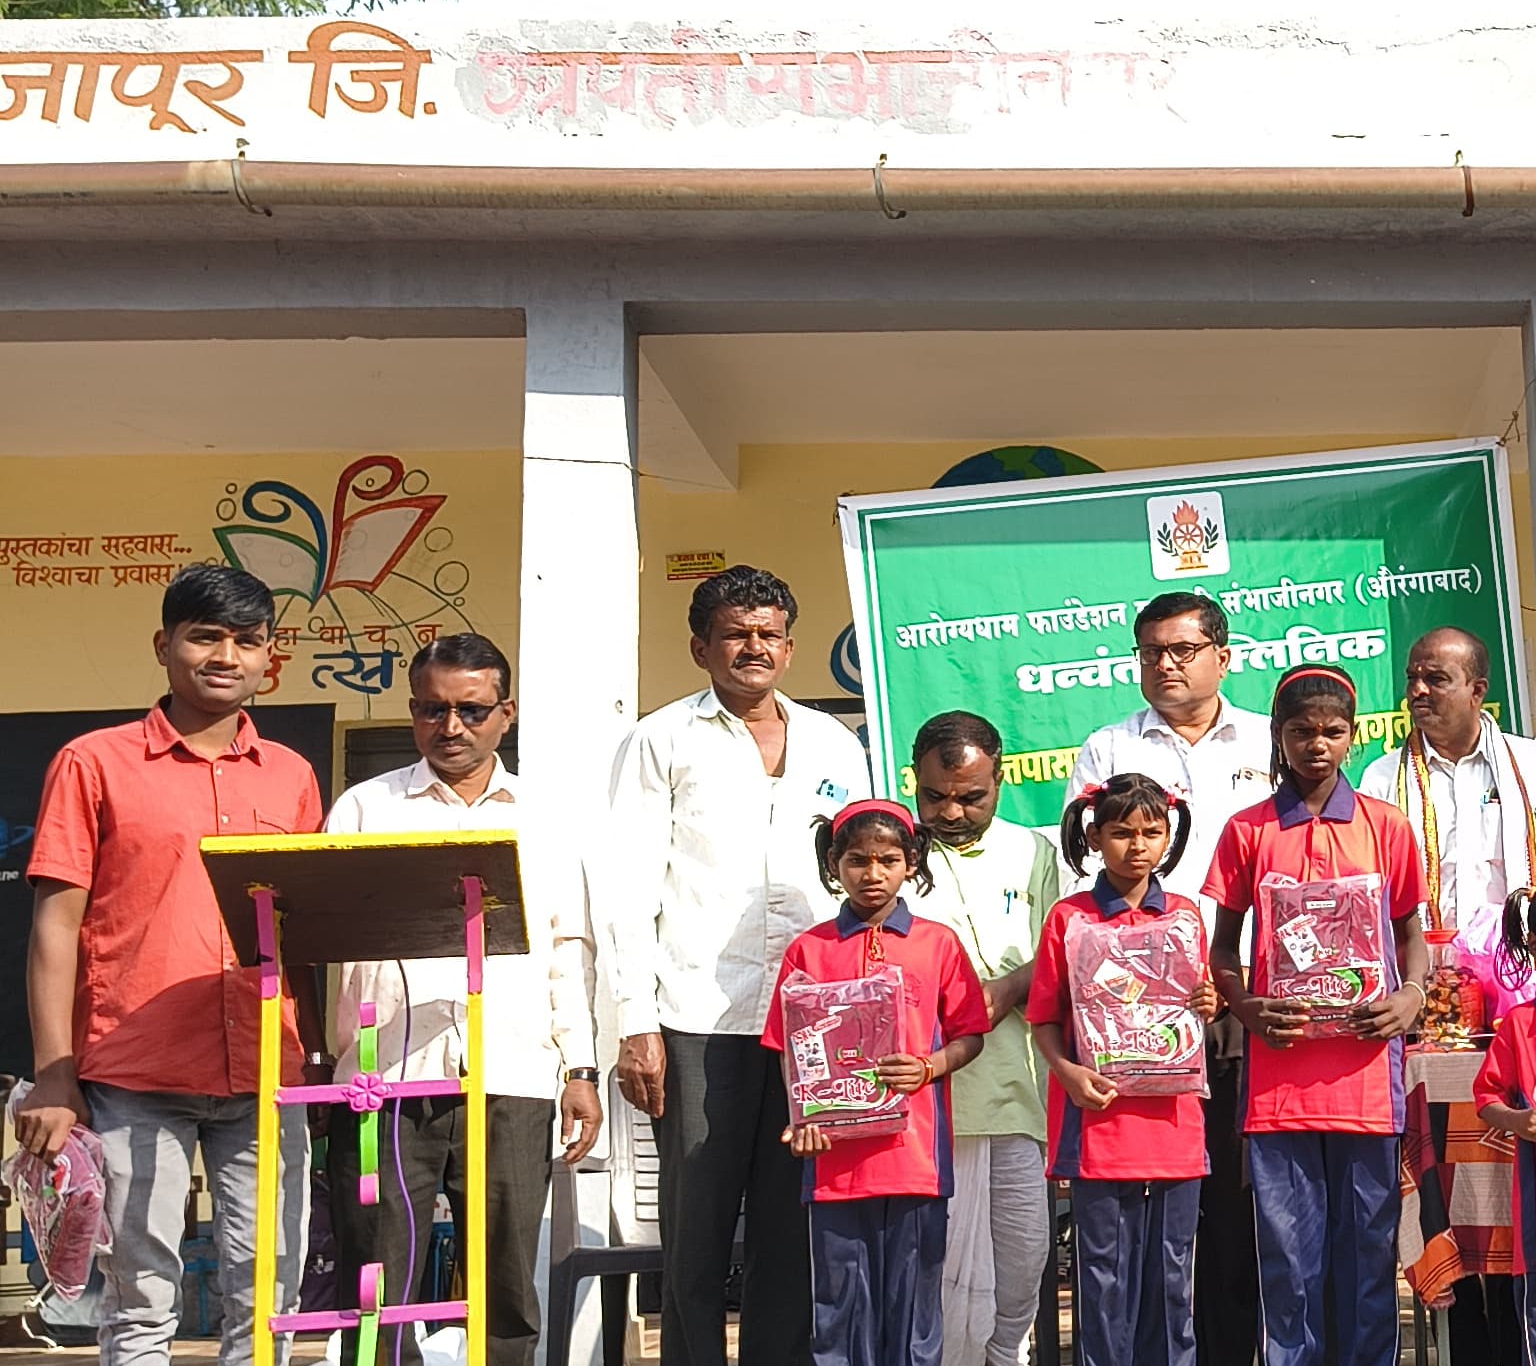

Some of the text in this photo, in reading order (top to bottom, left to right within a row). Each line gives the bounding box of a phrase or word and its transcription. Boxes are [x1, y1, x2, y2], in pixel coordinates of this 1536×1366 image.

[287, 20, 437, 119] जि.
[12, 560, 104, 587] विश्वाचा
[895, 611, 1019, 650] आरोग्यधाम
[1219, 577, 1346, 616] संभाजीनगर
[1355, 563, 1482, 606] (औरंगाबाद)
